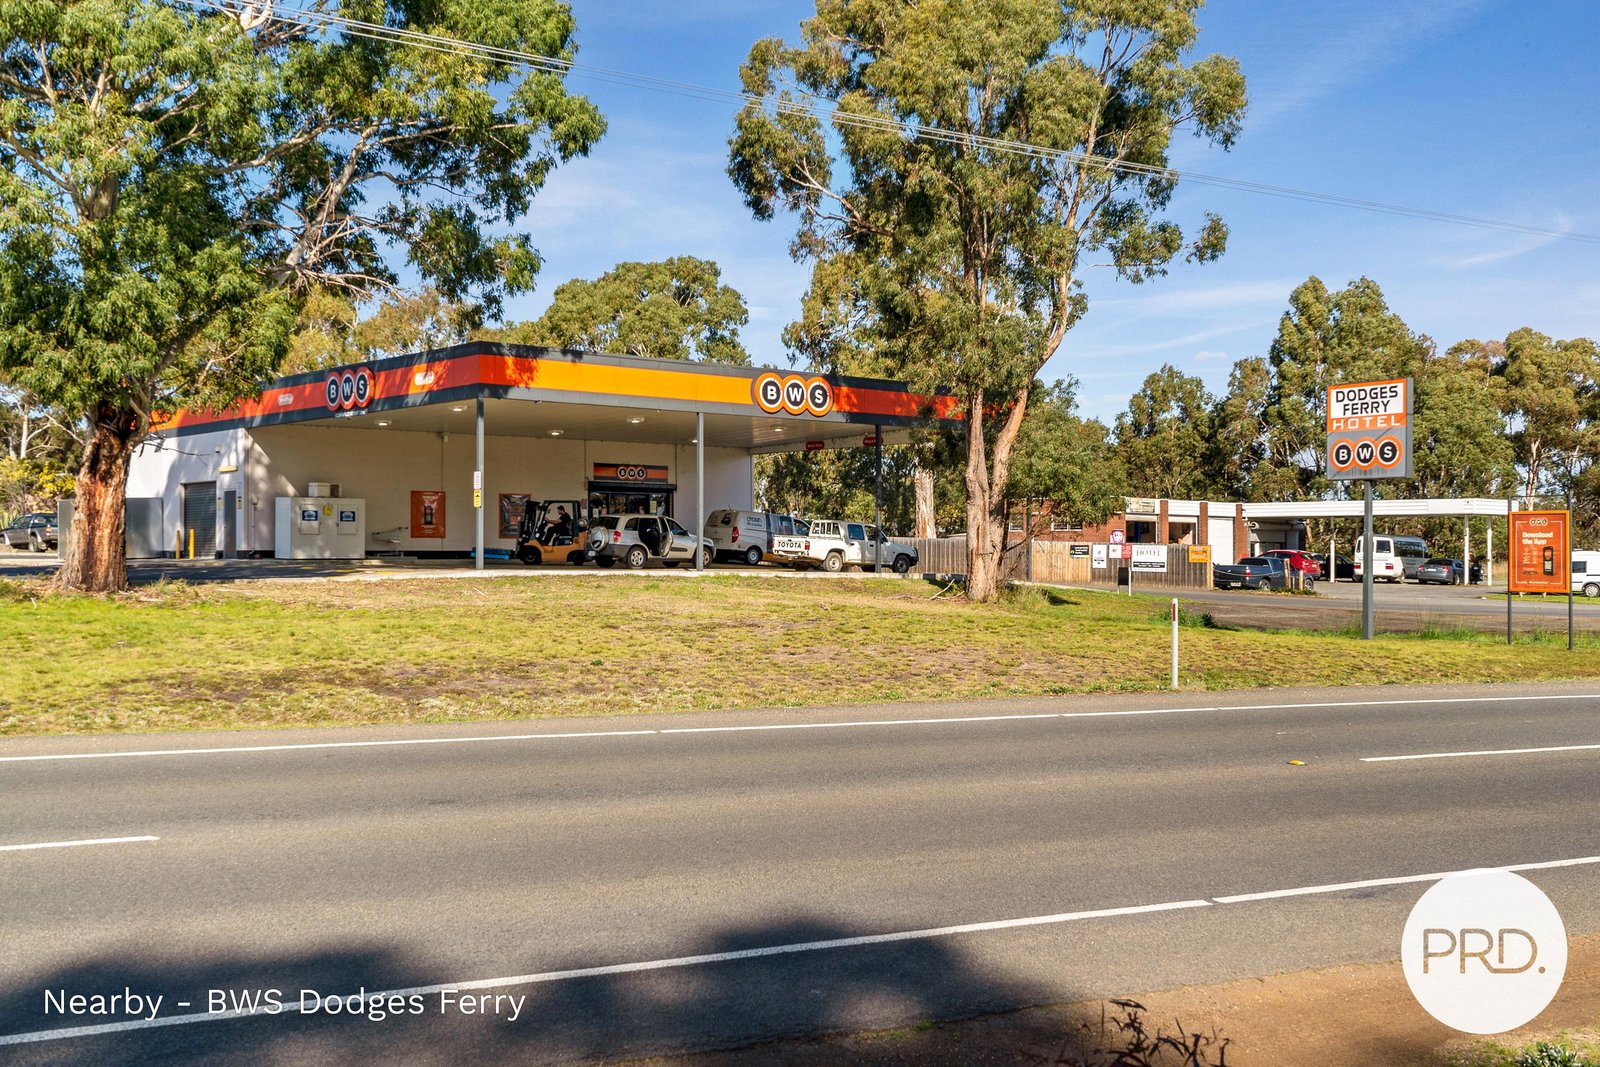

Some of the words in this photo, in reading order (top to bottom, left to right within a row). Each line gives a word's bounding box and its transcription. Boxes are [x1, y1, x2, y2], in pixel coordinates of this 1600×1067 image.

[1335, 385, 1398, 403] DODGES
[1343, 400, 1390, 416] FERRY
[1332, 415, 1400, 430] HOTEL
